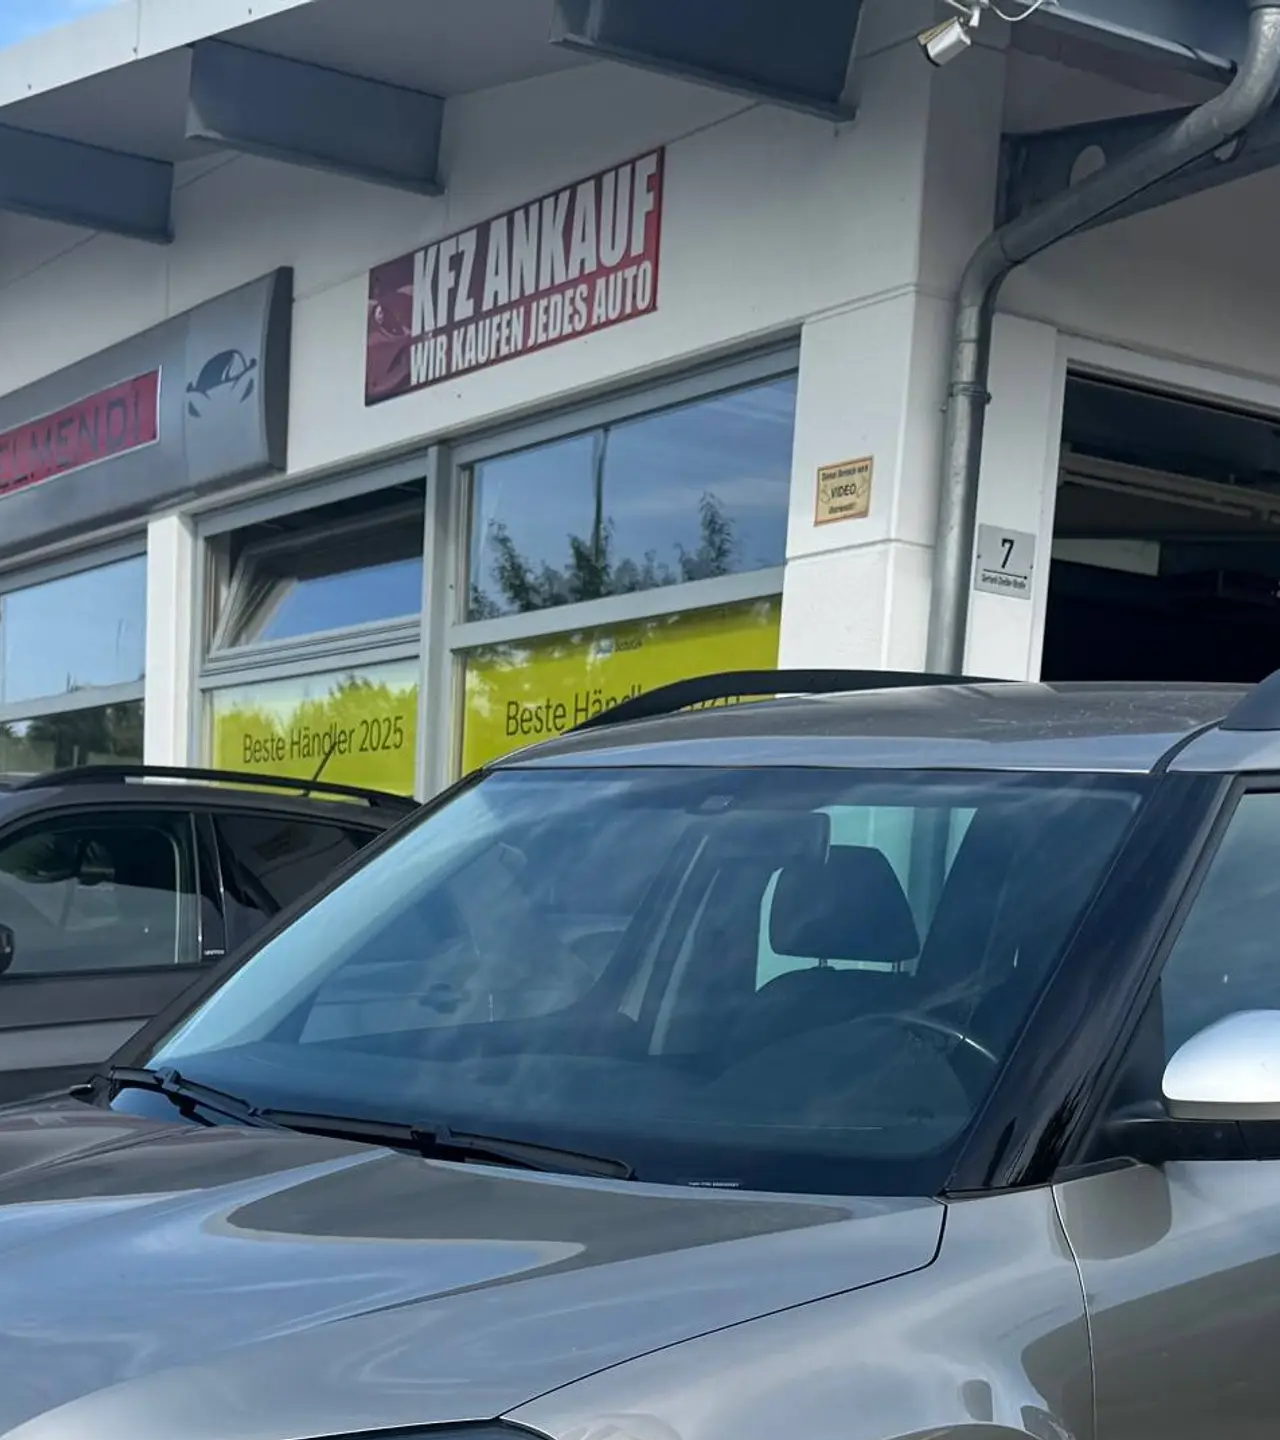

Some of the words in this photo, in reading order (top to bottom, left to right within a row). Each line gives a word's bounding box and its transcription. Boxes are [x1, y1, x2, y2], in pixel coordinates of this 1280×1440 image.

[411, 228, 478, 338] KFZ
[482, 152, 658, 318] ANKAUF
[410, 334, 448, 386] WIR
[451, 304, 525, 373] KAUFEN
[526, 283, 589, 348] JEDES
[591, 260, 653, 333] AUTO
[830, 482, 857, 499] VIDEO
[1001, 537, 1015, 569] 7
[506, 696, 567, 737] Beste
[243, 732, 286, 764] Beste
[290, 722, 355, 760] Händler
[359, 715, 404, 753] 2025
